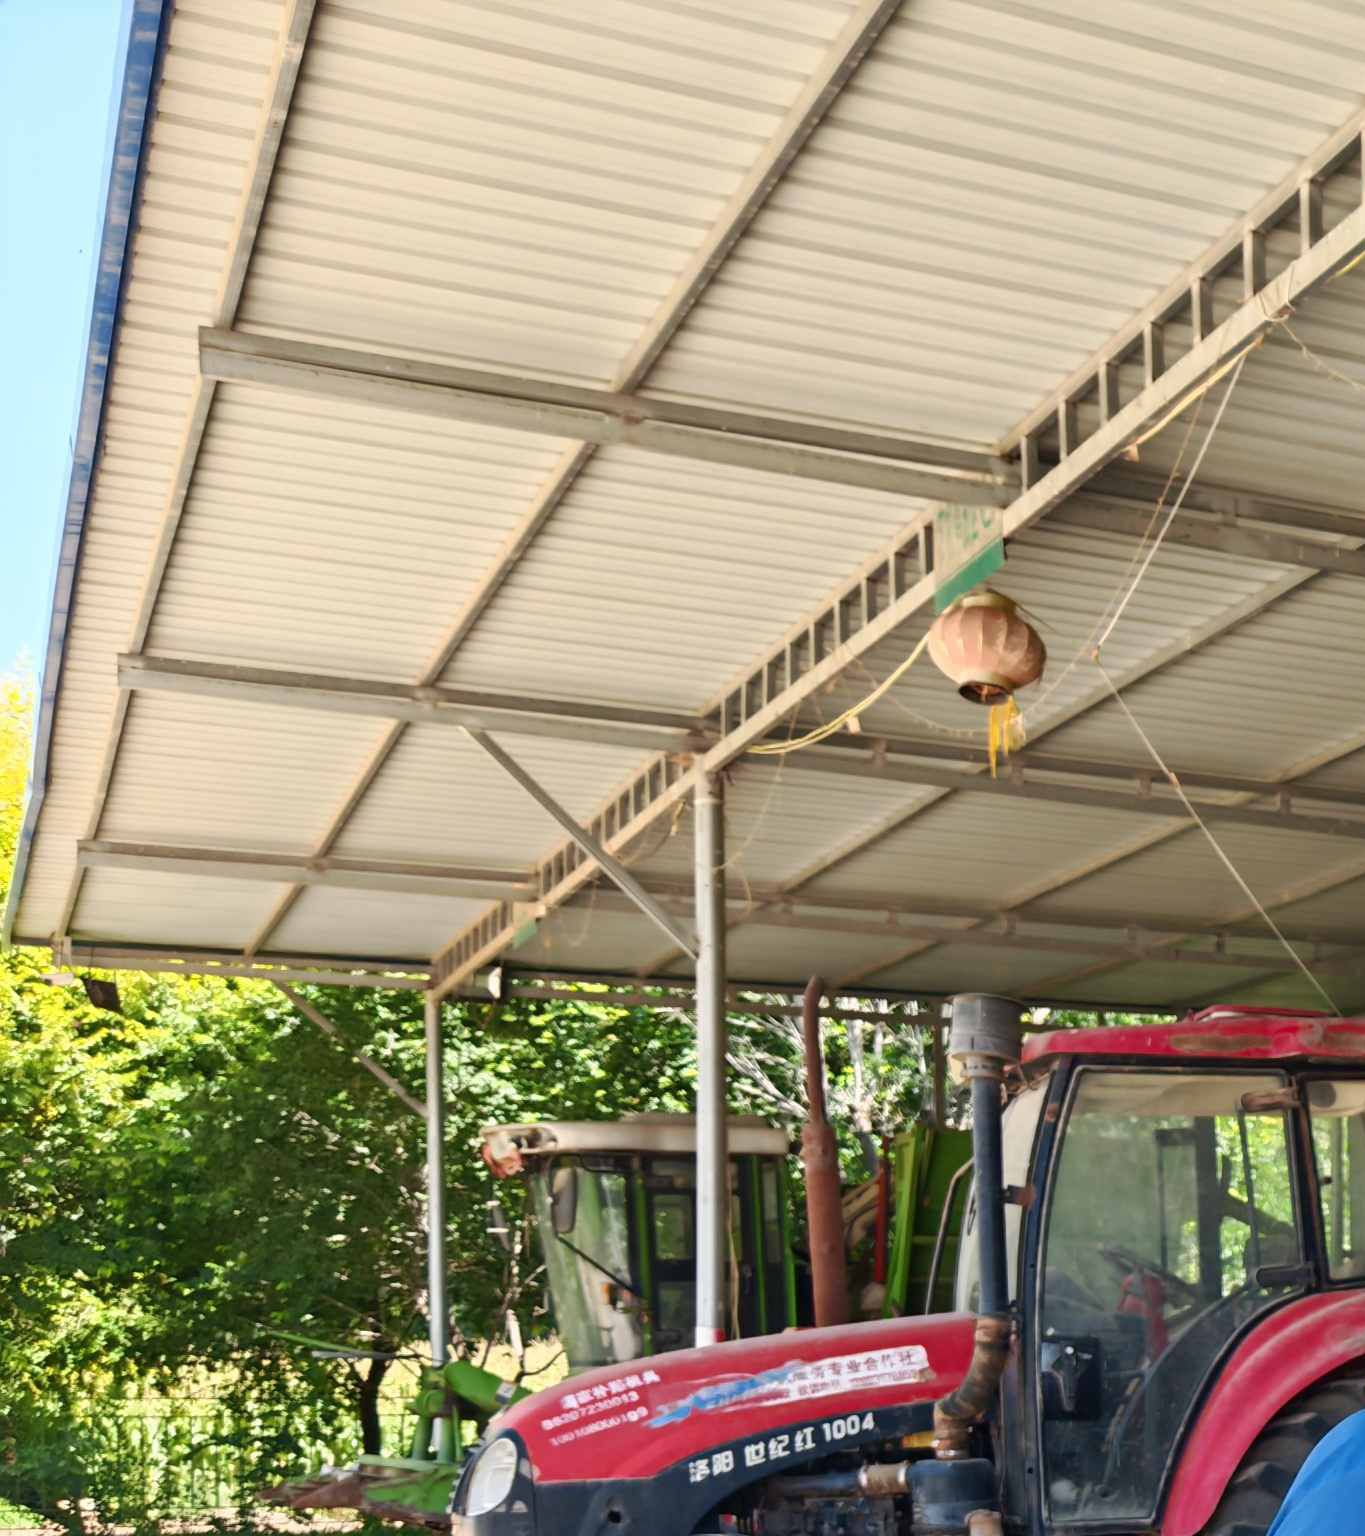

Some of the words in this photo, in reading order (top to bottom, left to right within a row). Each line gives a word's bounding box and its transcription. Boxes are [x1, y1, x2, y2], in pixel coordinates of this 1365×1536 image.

[688, 1449, 735, 1484] 洛阳
[743, 1426, 817, 1468] 世纪红
[821, 1412, 876, 1443] 1004
